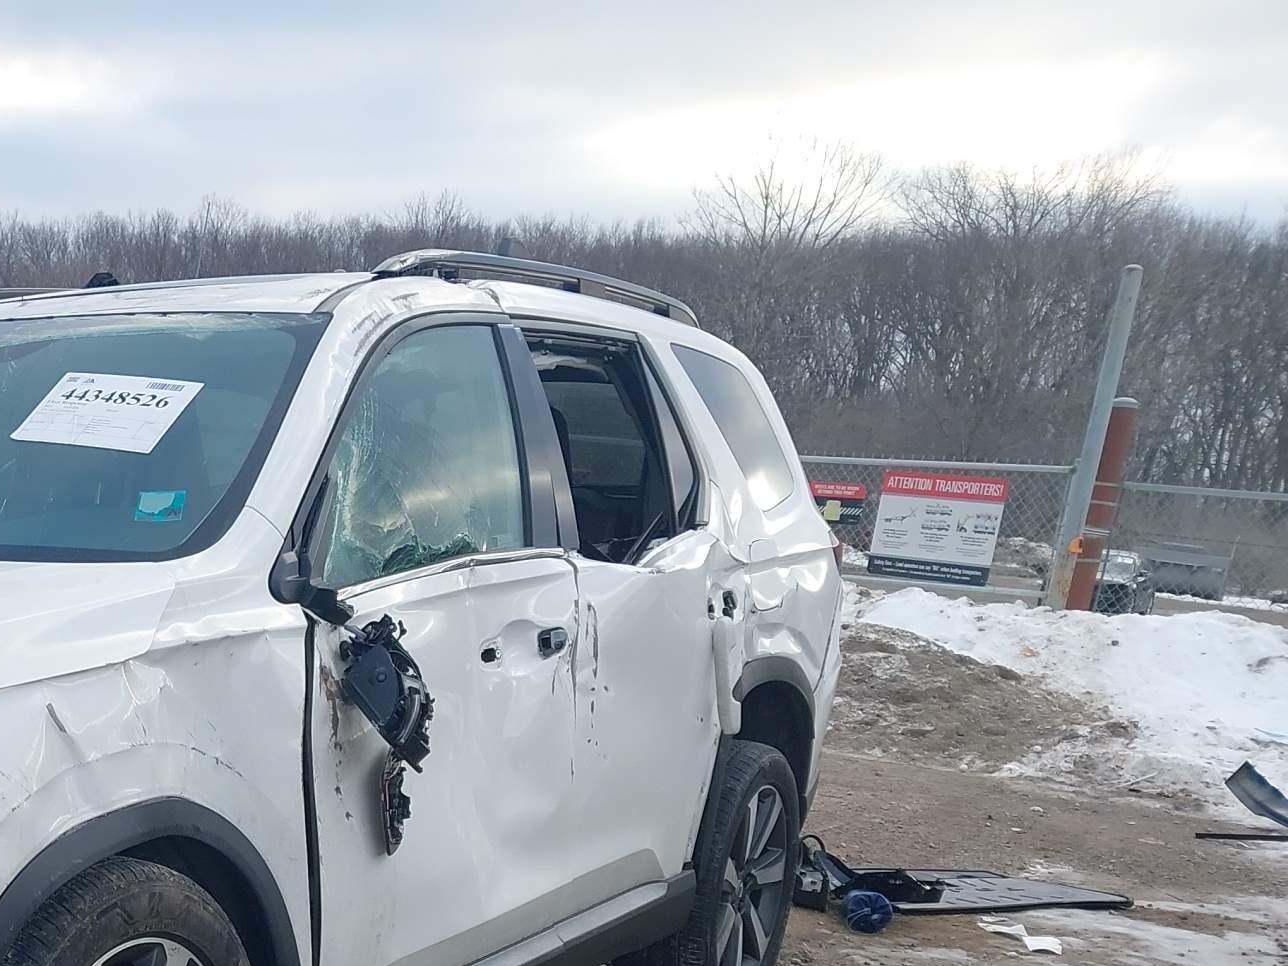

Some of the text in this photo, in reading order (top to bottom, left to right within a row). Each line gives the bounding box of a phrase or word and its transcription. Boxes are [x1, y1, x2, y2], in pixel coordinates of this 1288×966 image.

[61, 387, 174, 409] 44348526
[887, 476, 1004, 497] ATTENTION TRANSPORTERS!
